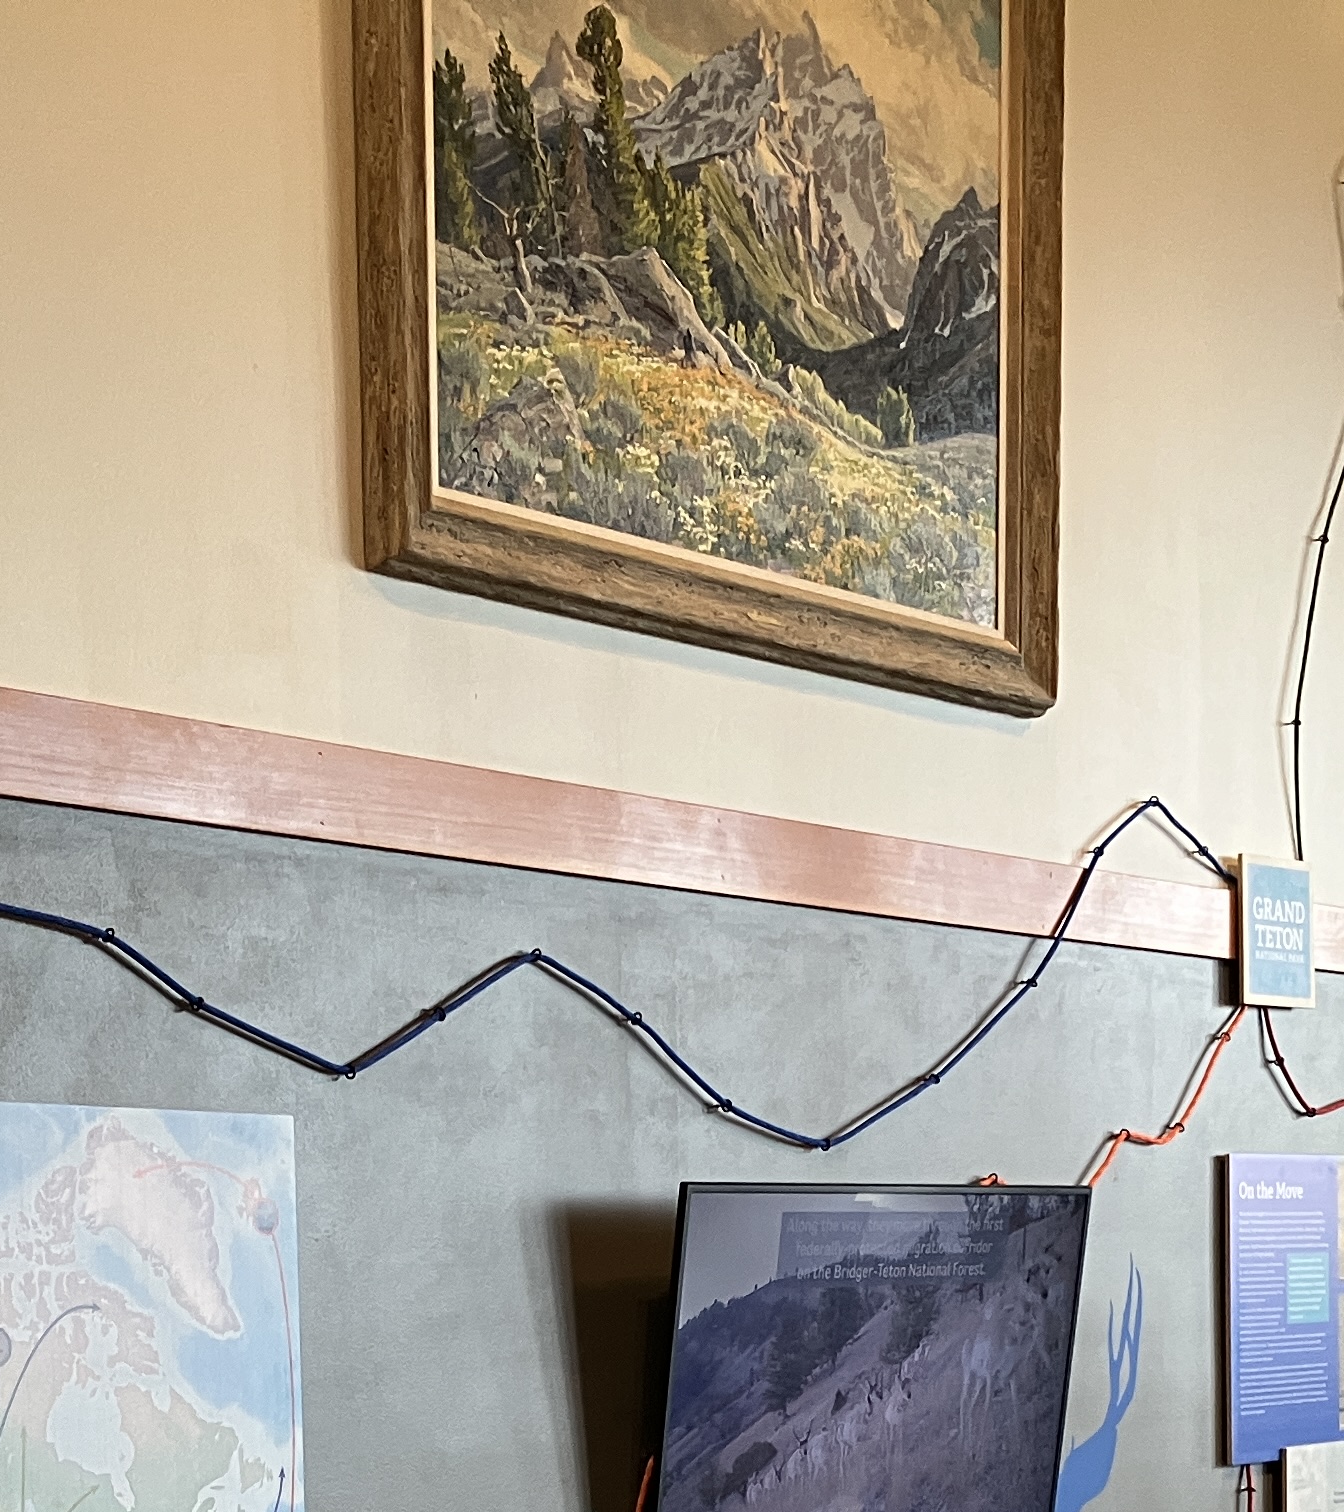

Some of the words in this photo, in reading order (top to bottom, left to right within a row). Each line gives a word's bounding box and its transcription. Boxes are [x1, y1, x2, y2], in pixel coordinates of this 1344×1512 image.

[1253, 896, 1305, 924] GRAND
[1255, 924, 1303, 951] TETON
[1239, 1182, 1255, 1199] On
[1256, 1181, 1274, 1199] the
[1275, 1183, 1303, 1200] Move
[787, 1218, 818, 1234] Along
[984, 1218, 1003, 1231] first
[796, 1269, 810, 1280] on
[834, 1263, 906, 1282] Bridger-Teton
[909, 1263, 950, 1277] National
[952, 1263, 985, 1276] Forest.
